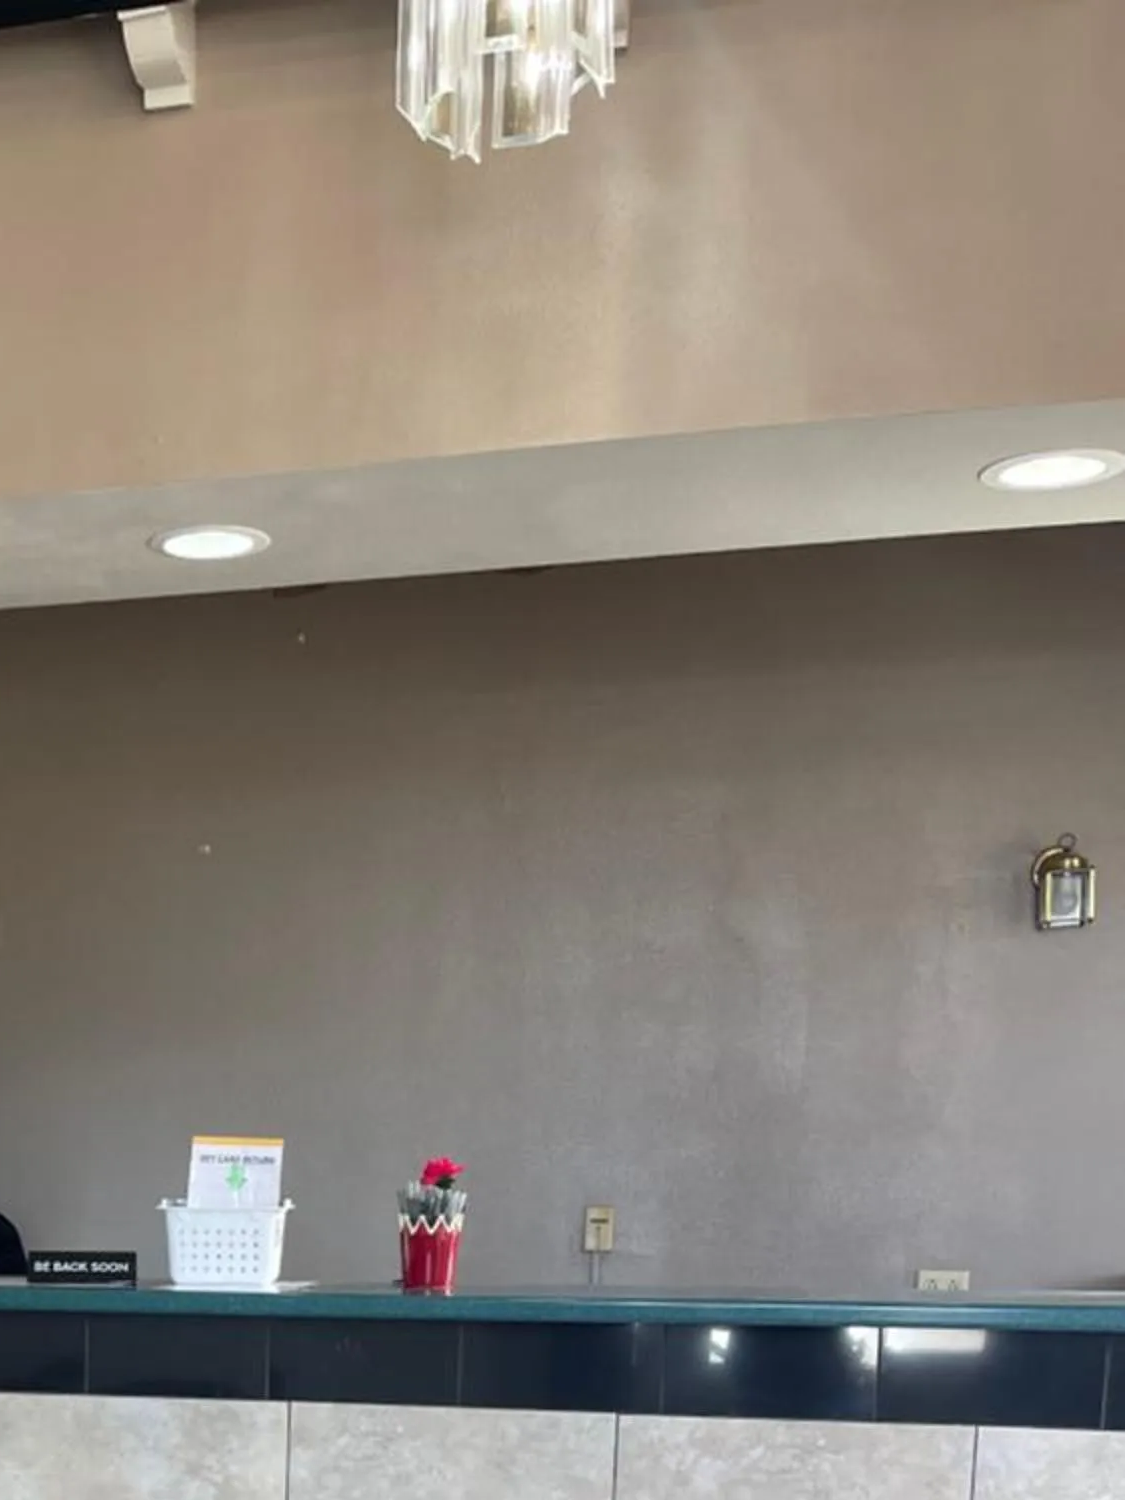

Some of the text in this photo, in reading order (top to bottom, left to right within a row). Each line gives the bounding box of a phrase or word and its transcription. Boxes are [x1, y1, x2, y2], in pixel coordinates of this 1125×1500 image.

[34, 1261, 129, 1273] BE BACK SOON
